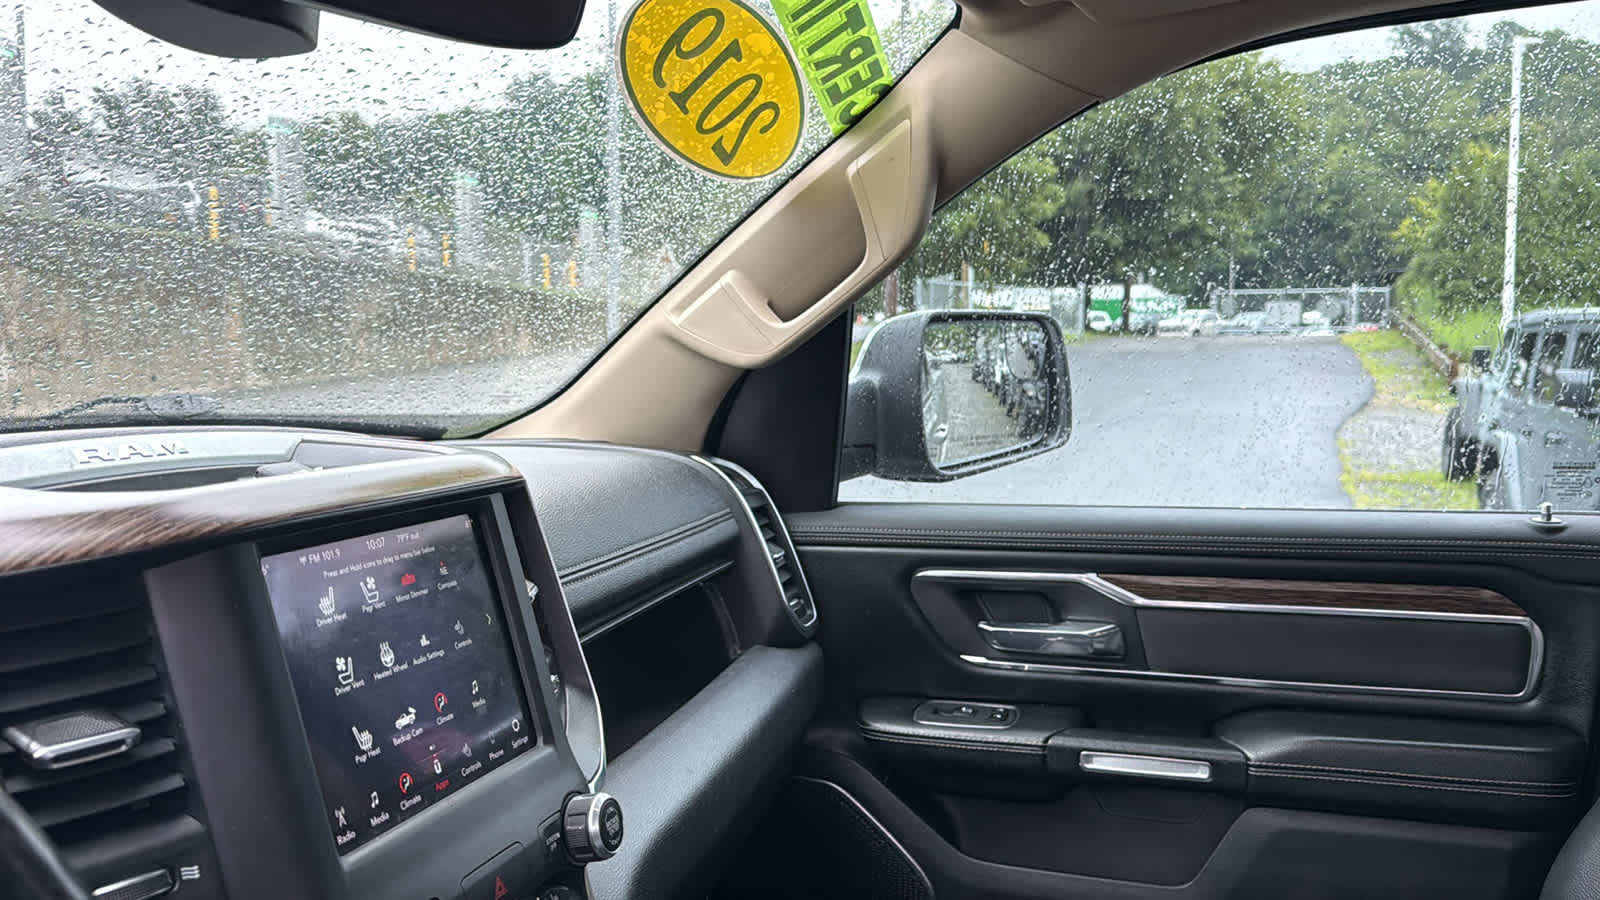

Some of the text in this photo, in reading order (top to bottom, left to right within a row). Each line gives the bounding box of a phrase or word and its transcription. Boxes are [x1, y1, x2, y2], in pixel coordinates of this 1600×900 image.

[77, 441, 190, 464] RAM
[366, 536, 385, 550] 10:07
[308, 554, 320, 563] FM
[323, 570, 338, 579] Press
[339, 566, 349, 575] and
[350, 563, 362, 571] Hold
[363, 561, 376, 569] icons
[383, 556, 394, 564] drag
[315, 612, 348, 628] Driver Heat
[412, 649, 445, 666] Audio Settings
[373, 660, 409, 681] Heated Wheel
[334, 679, 366, 697] Driver Vent
[436, 713, 455, 726] Climate
[392, 727, 425, 747] Backup Cam
[367, 745, 381, 759] Heat
[336, 830, 356, 845] Radio
[370, 812, 390, 827] Media
[400, 794, 422, 811] Climate
[461, 760, 482, 777] Controls
[489, 748, 504, 761] Phone
[511, 735, 529, 749] Settings
